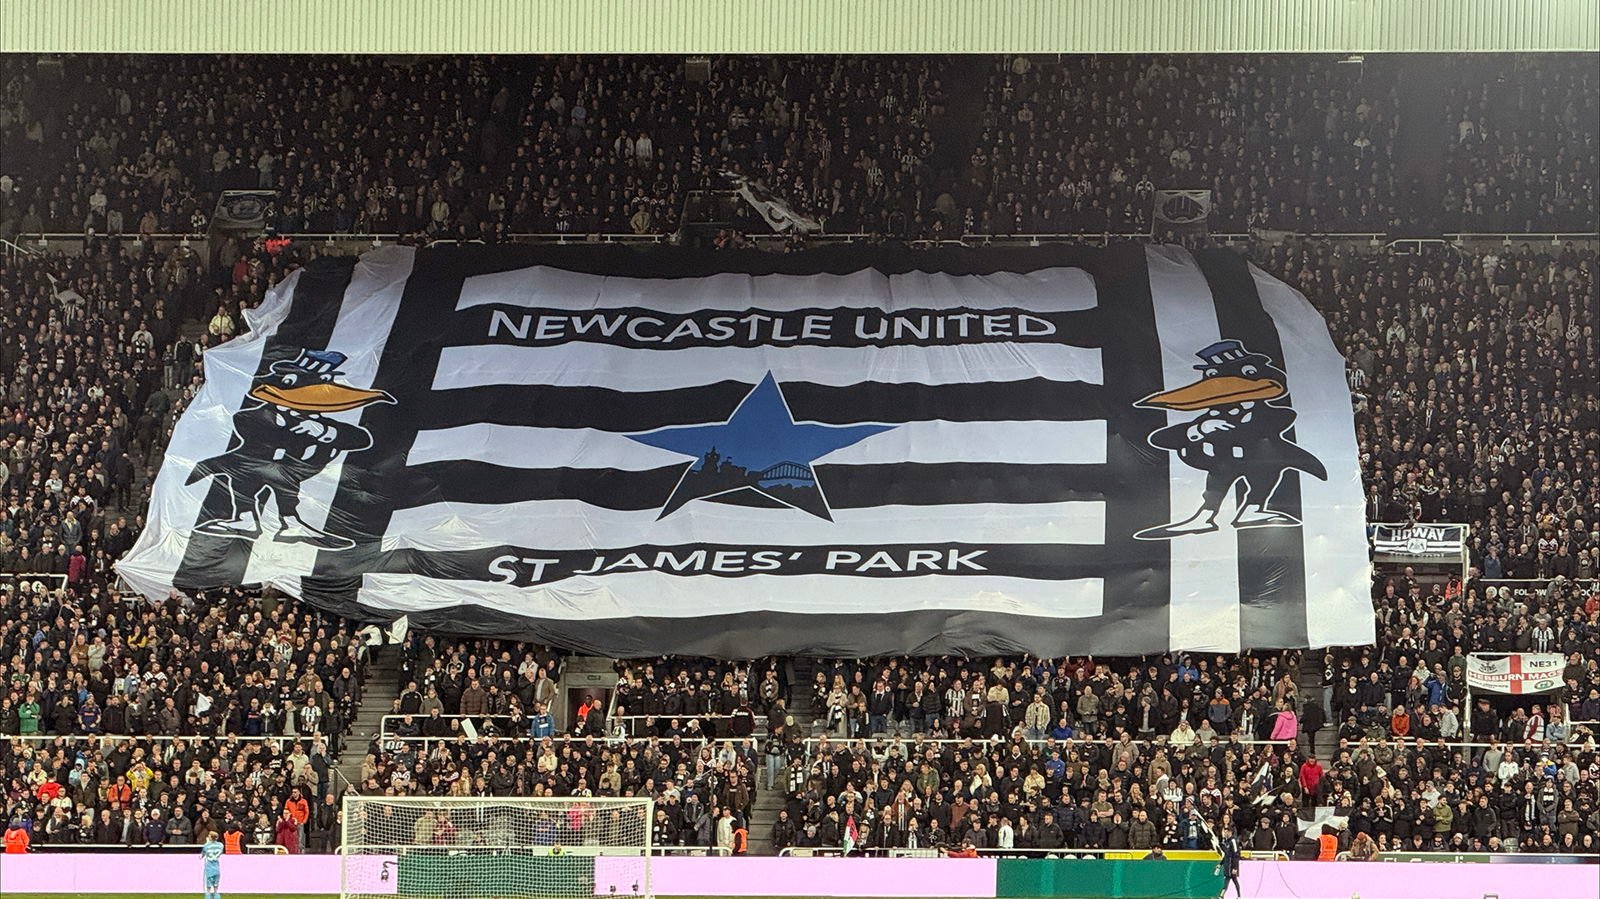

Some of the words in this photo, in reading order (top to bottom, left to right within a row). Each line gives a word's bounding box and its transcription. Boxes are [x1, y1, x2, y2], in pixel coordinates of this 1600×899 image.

[488, 309, 834, 343] NEWCASTLE
[854, 314, 1057, 340] UNITED
[1391, 527, 1446, 542] HOWAY
[488, 554, 560, 584] ST
[572, 550, 803, 575] JAMES'
[825, 549, 989, 572] PARK
[1514, 588, 1548, 597] FOLW
[1529, 660, 1558, 669] NE31
[1467, 671, 1525, 681] HEBBURN
[1528, 668, 1564, 680] MAGS
